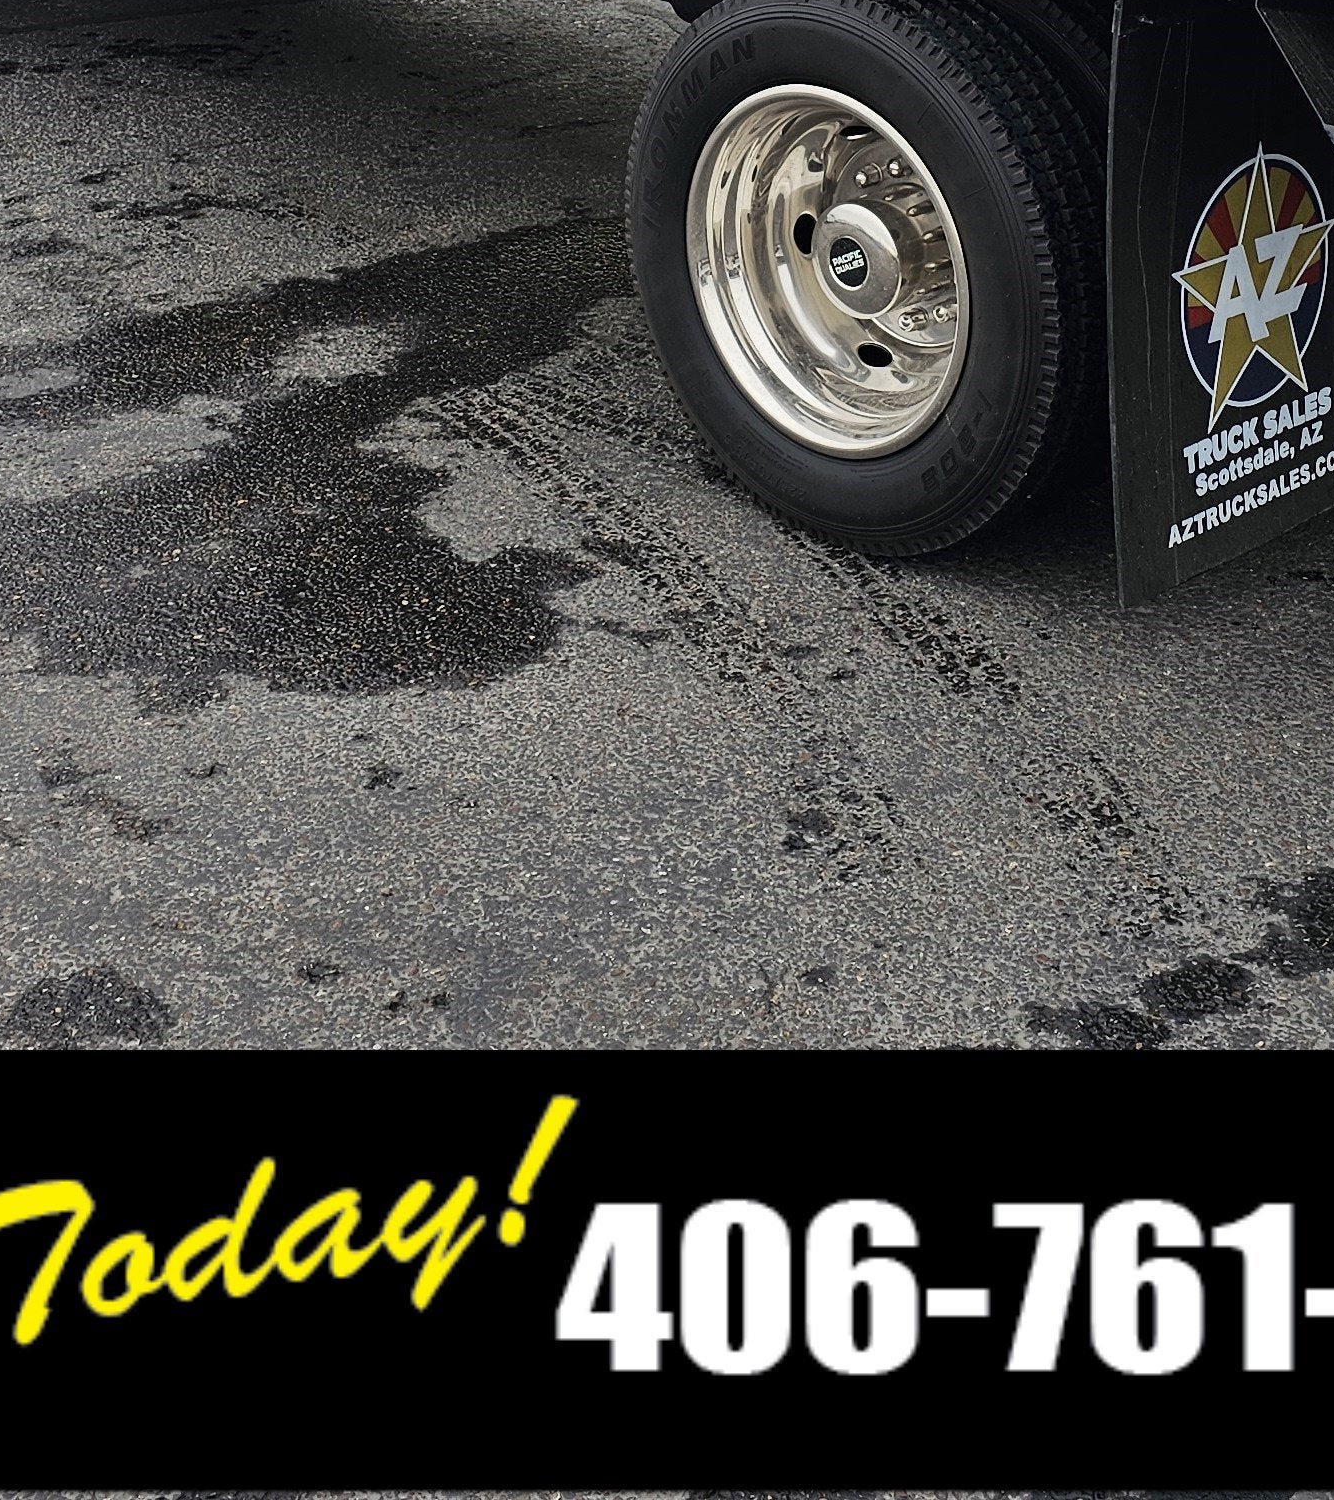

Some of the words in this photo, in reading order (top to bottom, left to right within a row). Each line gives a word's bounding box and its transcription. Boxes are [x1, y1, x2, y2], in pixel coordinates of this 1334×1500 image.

[641, 33, 756, 229] IRONMAN
[832, 249, 863, 266] PACIFIC
[1208, 224, 1307, 343] AZ
[1183, 417, 1260, 474] TRUCK
[1263, 387, 1332, 439] SALES
[1195, 440, 1295, 496] Scottsdale,
[1300, 421, 1324, 450] AZ
